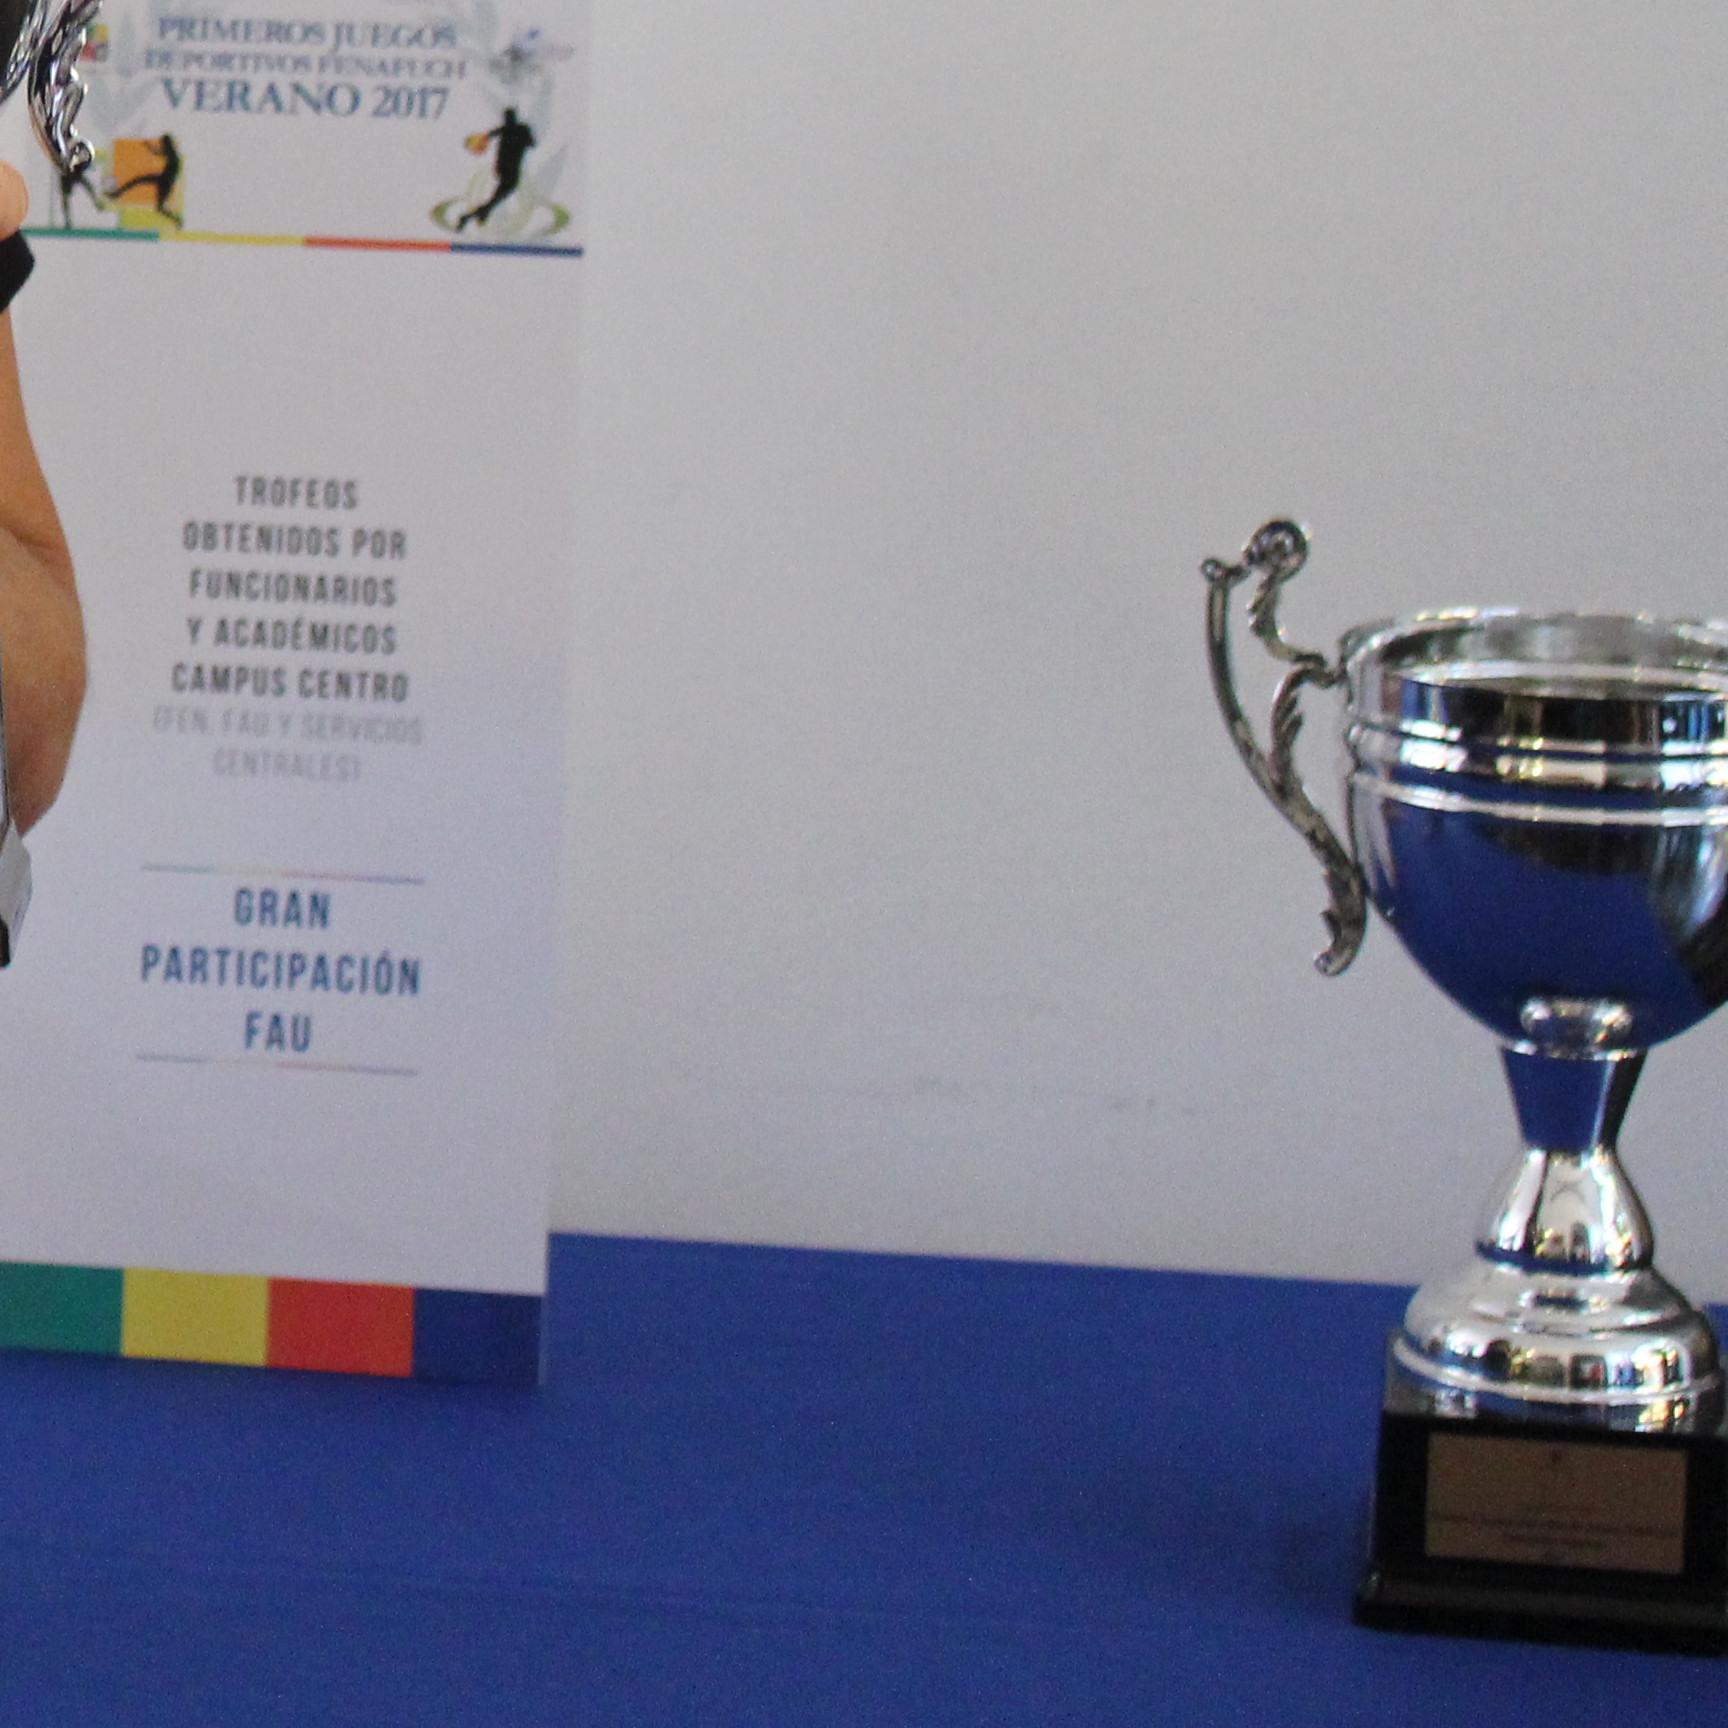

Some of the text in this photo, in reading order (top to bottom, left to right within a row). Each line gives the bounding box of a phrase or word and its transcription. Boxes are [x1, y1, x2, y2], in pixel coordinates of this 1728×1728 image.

[158, 16, 458, 52] PRIMEROS JUEGOS
[144, 49, 311, 73] DEPORTIVOS
[159, 76, 450, 120] VERANO 2017
[234, 475, 359, 511] TROFEOS
[182, 520, 409, 561] OBTENIDOS POR
[188, 567, 398, 608] FUNCIONARIOS
[186, 615, 399, 656] Y ACADÉMICOS
[171, 662, 410, 704] CAMPUS CENTRO
[278, 712, 293, 738] Y
[300, 713, 424, 746] SERVICIOS
[234, 887, 332, 929] GRAN
[140, 944, 422, 997] PARTICIPACIÓN
[244, 1011, 313, 1053] FAU
